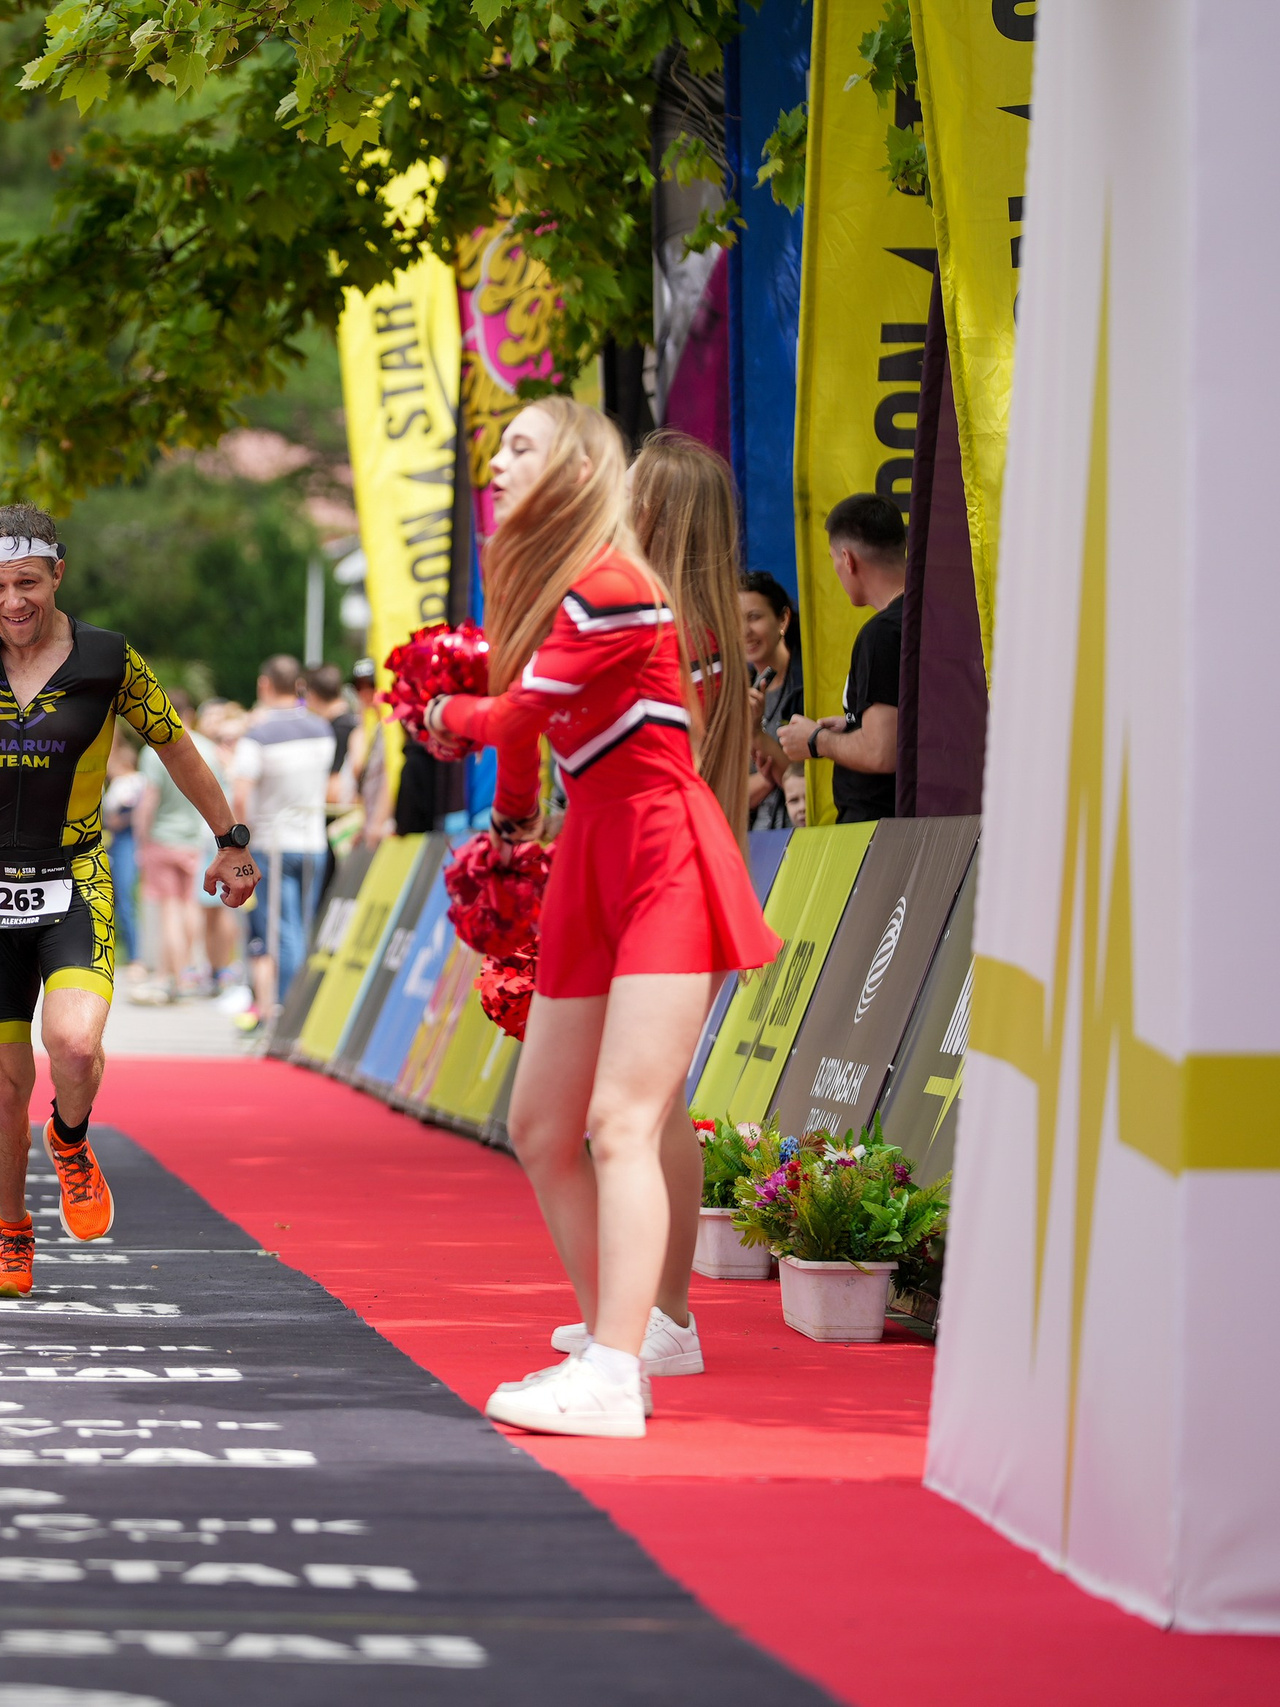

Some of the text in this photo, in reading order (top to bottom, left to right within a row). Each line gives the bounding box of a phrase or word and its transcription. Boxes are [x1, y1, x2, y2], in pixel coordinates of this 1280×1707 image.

[375, 299, 435, 441] STAR
[232, 863, 254, 877] 263
[0, 887, 45, 911] 263
[1, 916, 40, 925] ALEKSANDR
[768, 938, 816, 1027] STAR
[809, 1056, 870, 1106] ГАЗПРОМБАНК
[0, 1629, 487, 1666] STAR
